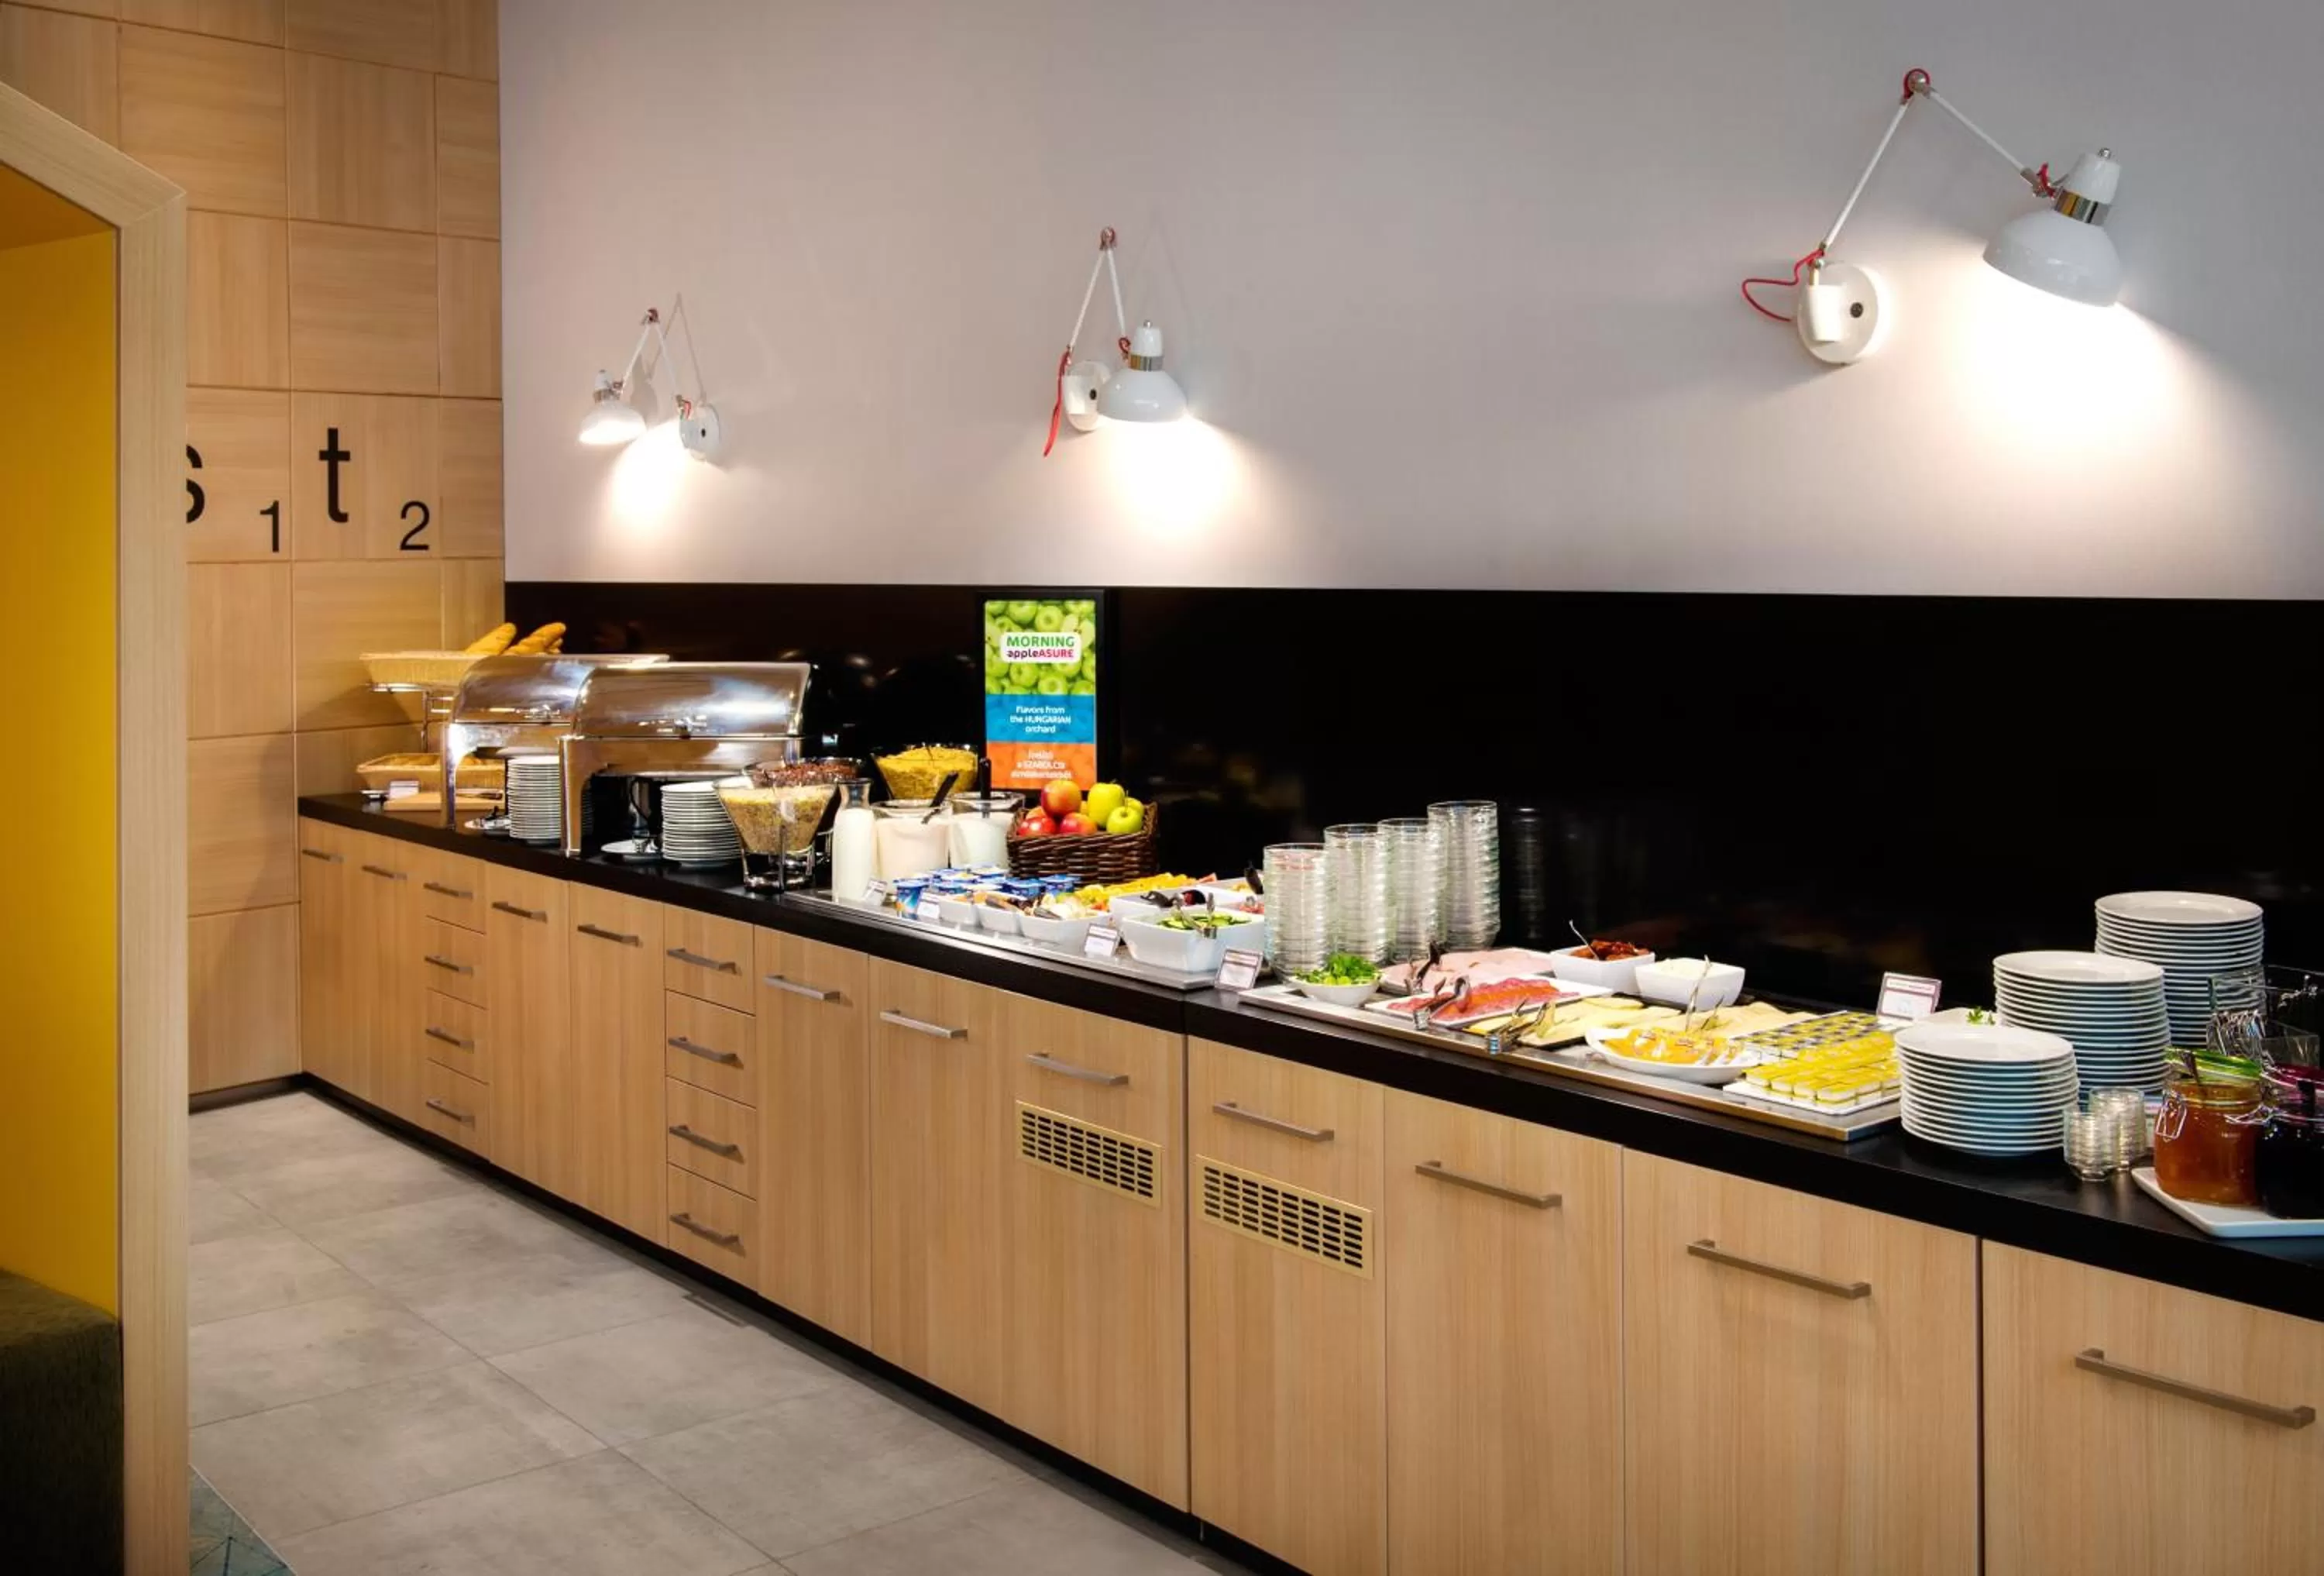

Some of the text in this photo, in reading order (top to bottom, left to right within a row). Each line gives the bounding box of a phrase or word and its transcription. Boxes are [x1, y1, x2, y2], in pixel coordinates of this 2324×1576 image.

[260, 428, 430, 552] 1 t 2
[1006, 635, 1074, 647] MORNING
[1006, 649, 1074, 659] appleASURE
[1016, 706, 1065, 714] Flavors from
[1024, 715, 1071, 724] HUNGARIAN
[1025, 725, 1056, 734] orchard
